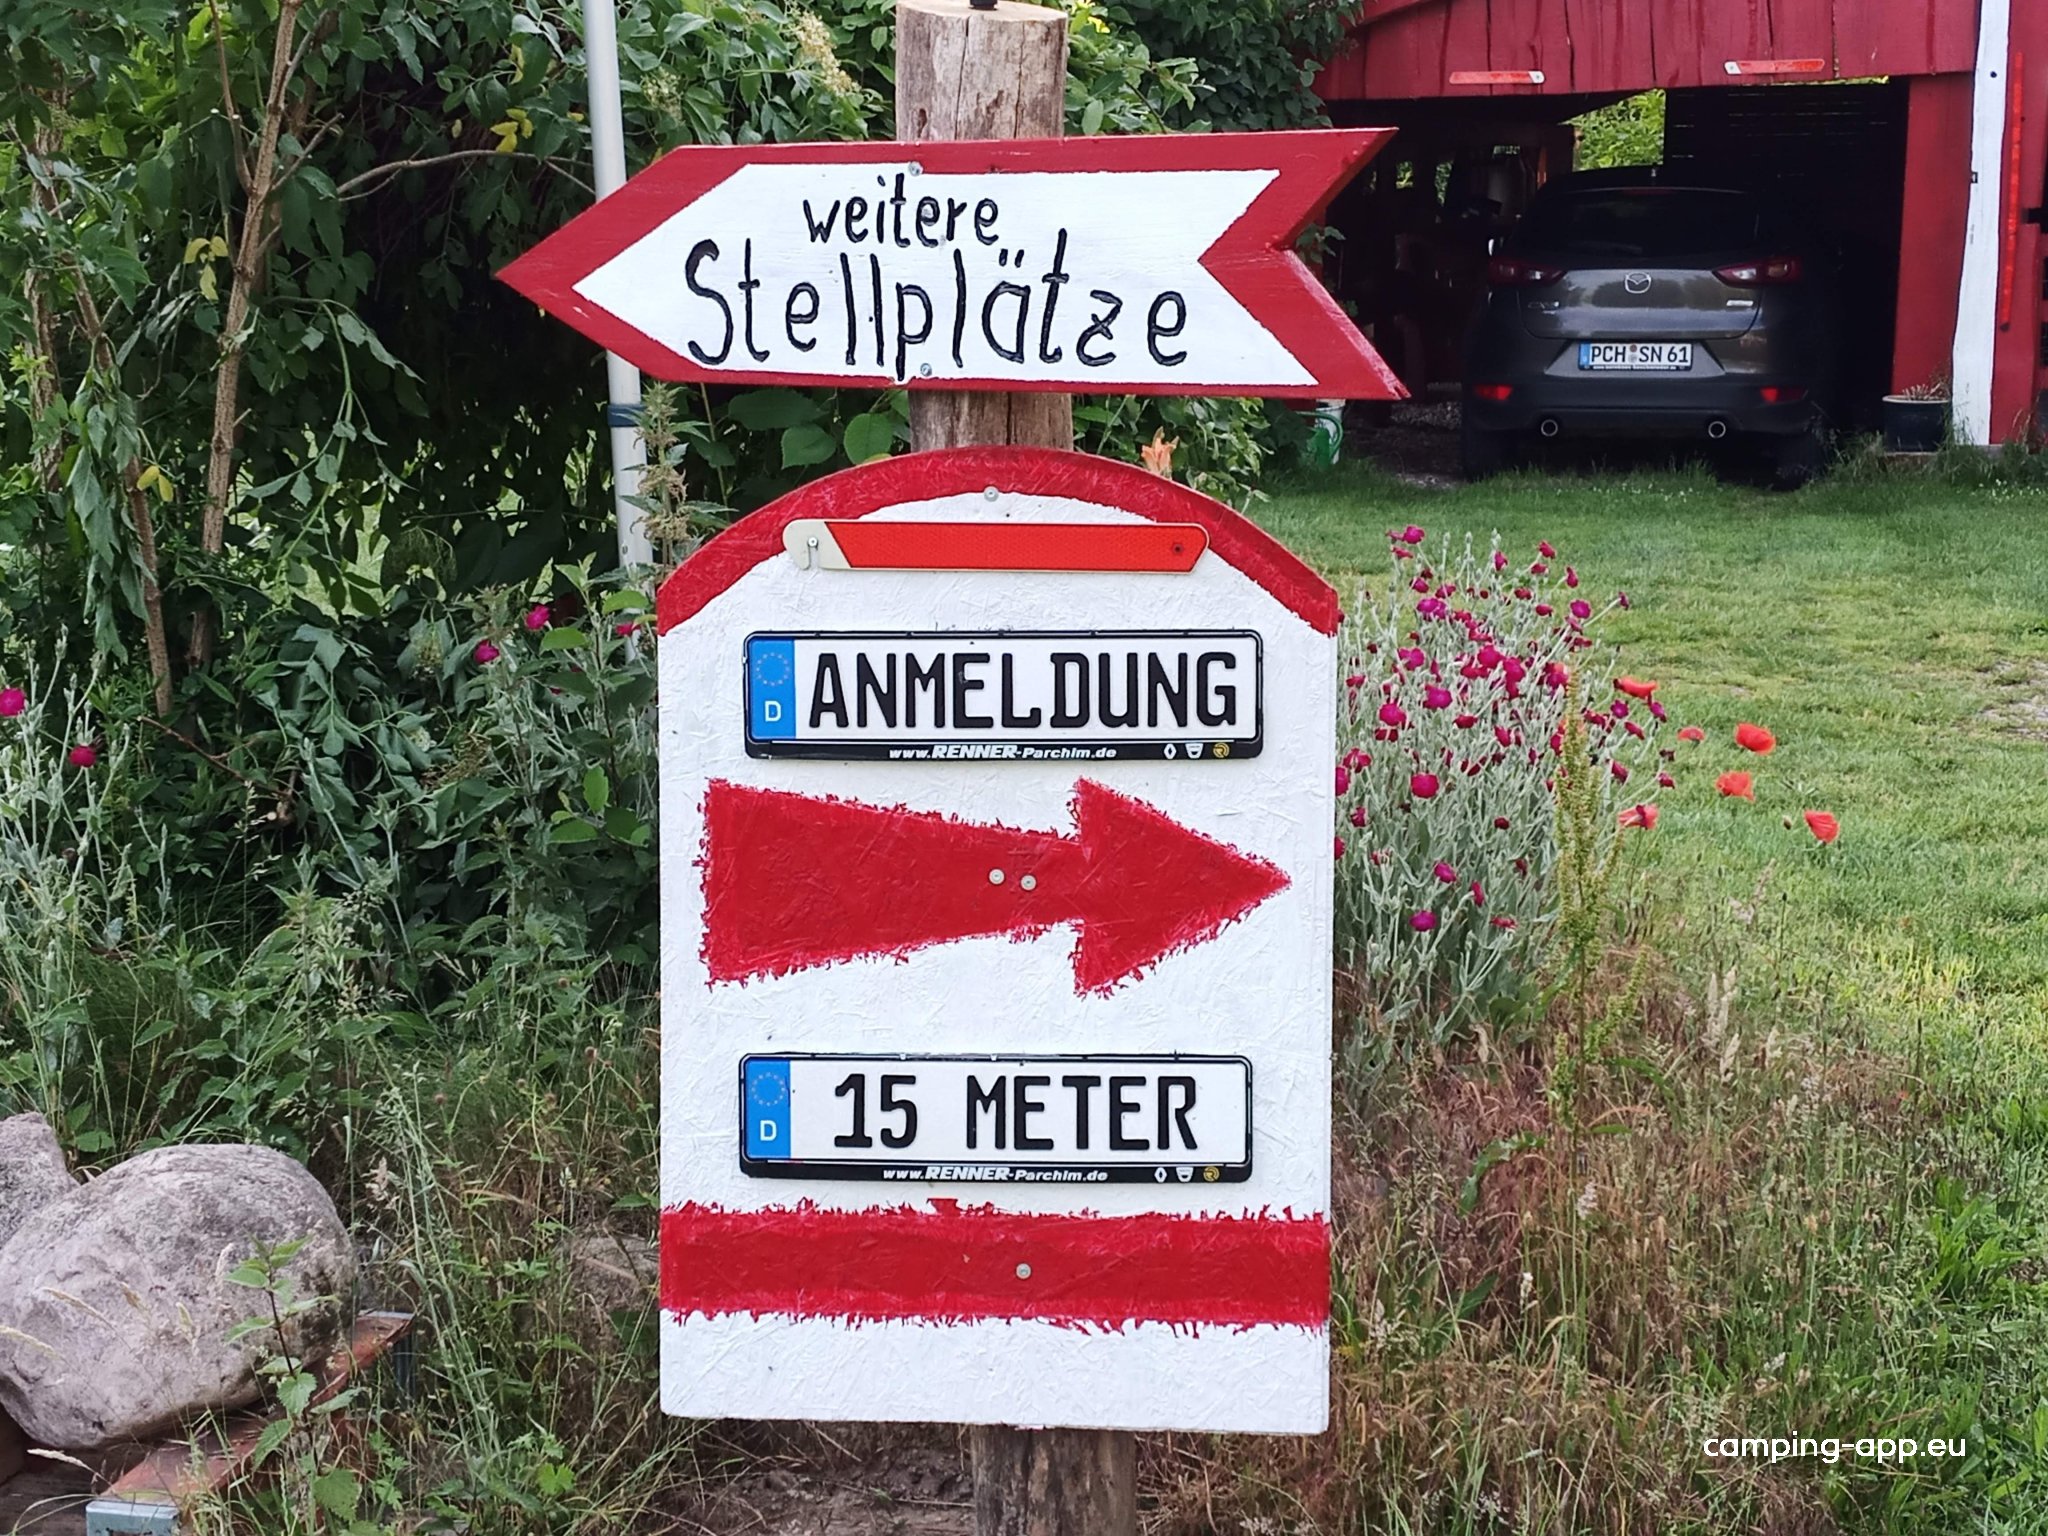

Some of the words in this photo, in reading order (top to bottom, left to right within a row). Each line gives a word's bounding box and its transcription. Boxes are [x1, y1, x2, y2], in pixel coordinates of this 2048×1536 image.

[804, 172, 999, 247] weitere
[684, 229, 1188, 381] Stellplätze
[1591, 345, 1627, 363] PCH
[1638, 345, 1663, 363] SN
[1667, 345, 1689, 363] 61
[764, 701, 781, 722] D
[808, 651, 1238, 729] ANMELDUNG
[889, 744, 1117, 760] www.RENNER-Parchim.de
[759, 1119, 777, 1142] D
[834, 1074, 918, 1149] 15
[966, 1075, 1198, 1151] METER
[883, 1165, 1109, 1182] www.RENNER-Parchim.de
